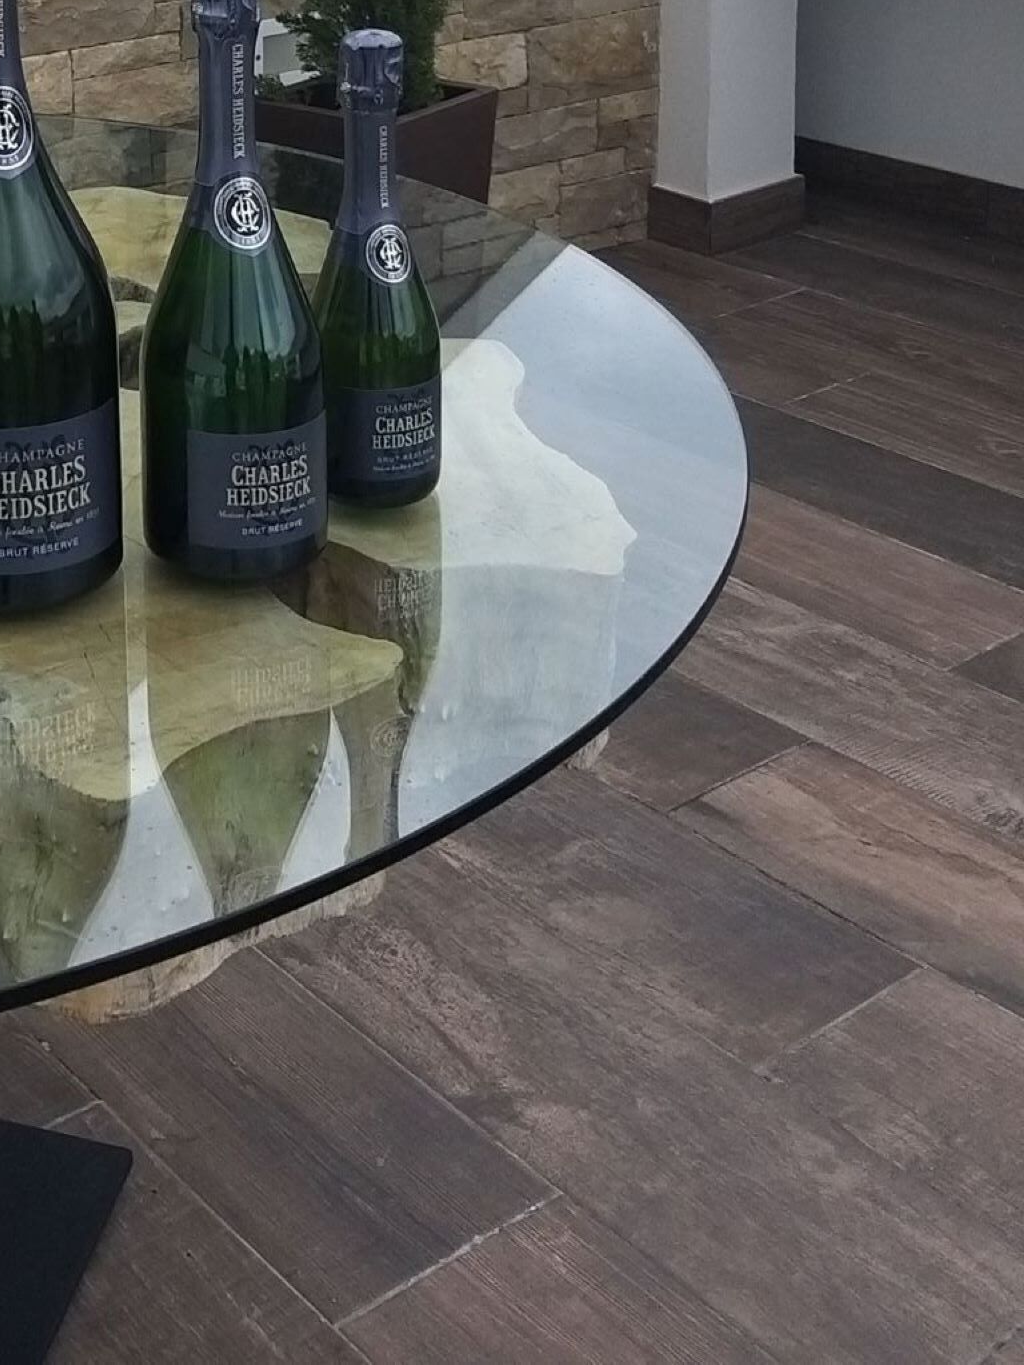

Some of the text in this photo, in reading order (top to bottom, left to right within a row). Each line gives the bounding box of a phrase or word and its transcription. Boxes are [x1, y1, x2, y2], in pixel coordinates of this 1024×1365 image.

[375, 407, 433, 434] CHARLES
[372, 423, 436, 449] HEIDSIECK
[231, 454, 308, 486] CHARLES
[226, 476, 311, 507] HEIDSIECK
[32, 536, 81, 555] RÉSERVE
